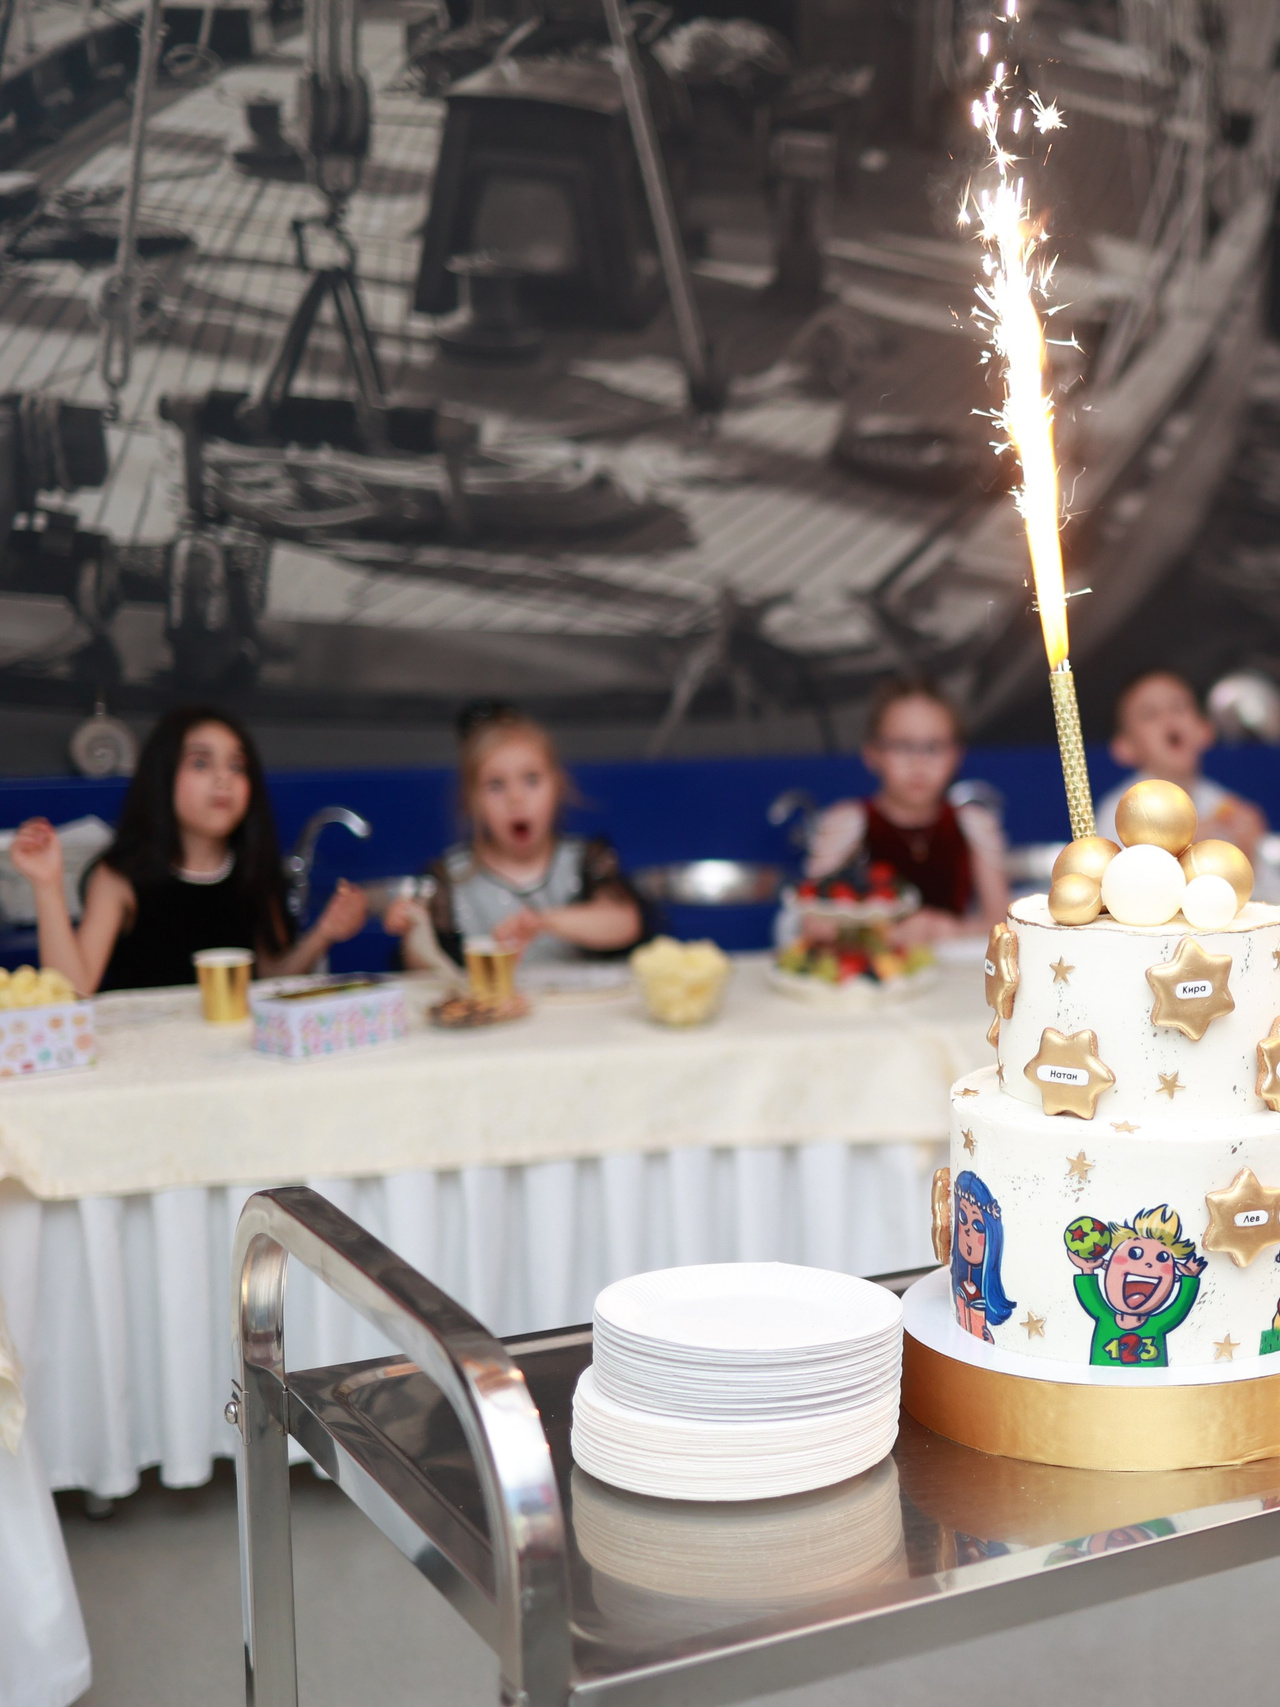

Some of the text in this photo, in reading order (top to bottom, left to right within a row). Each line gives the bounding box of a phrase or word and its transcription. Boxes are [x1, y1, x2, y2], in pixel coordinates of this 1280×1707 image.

[1182, 985, 1207, 994] Кира
[1050, 1070, 1078, 1080] Натан
[1243, 1215, 1260, 1223] Лев
[1103, 1333, 1159, 1363] 123
